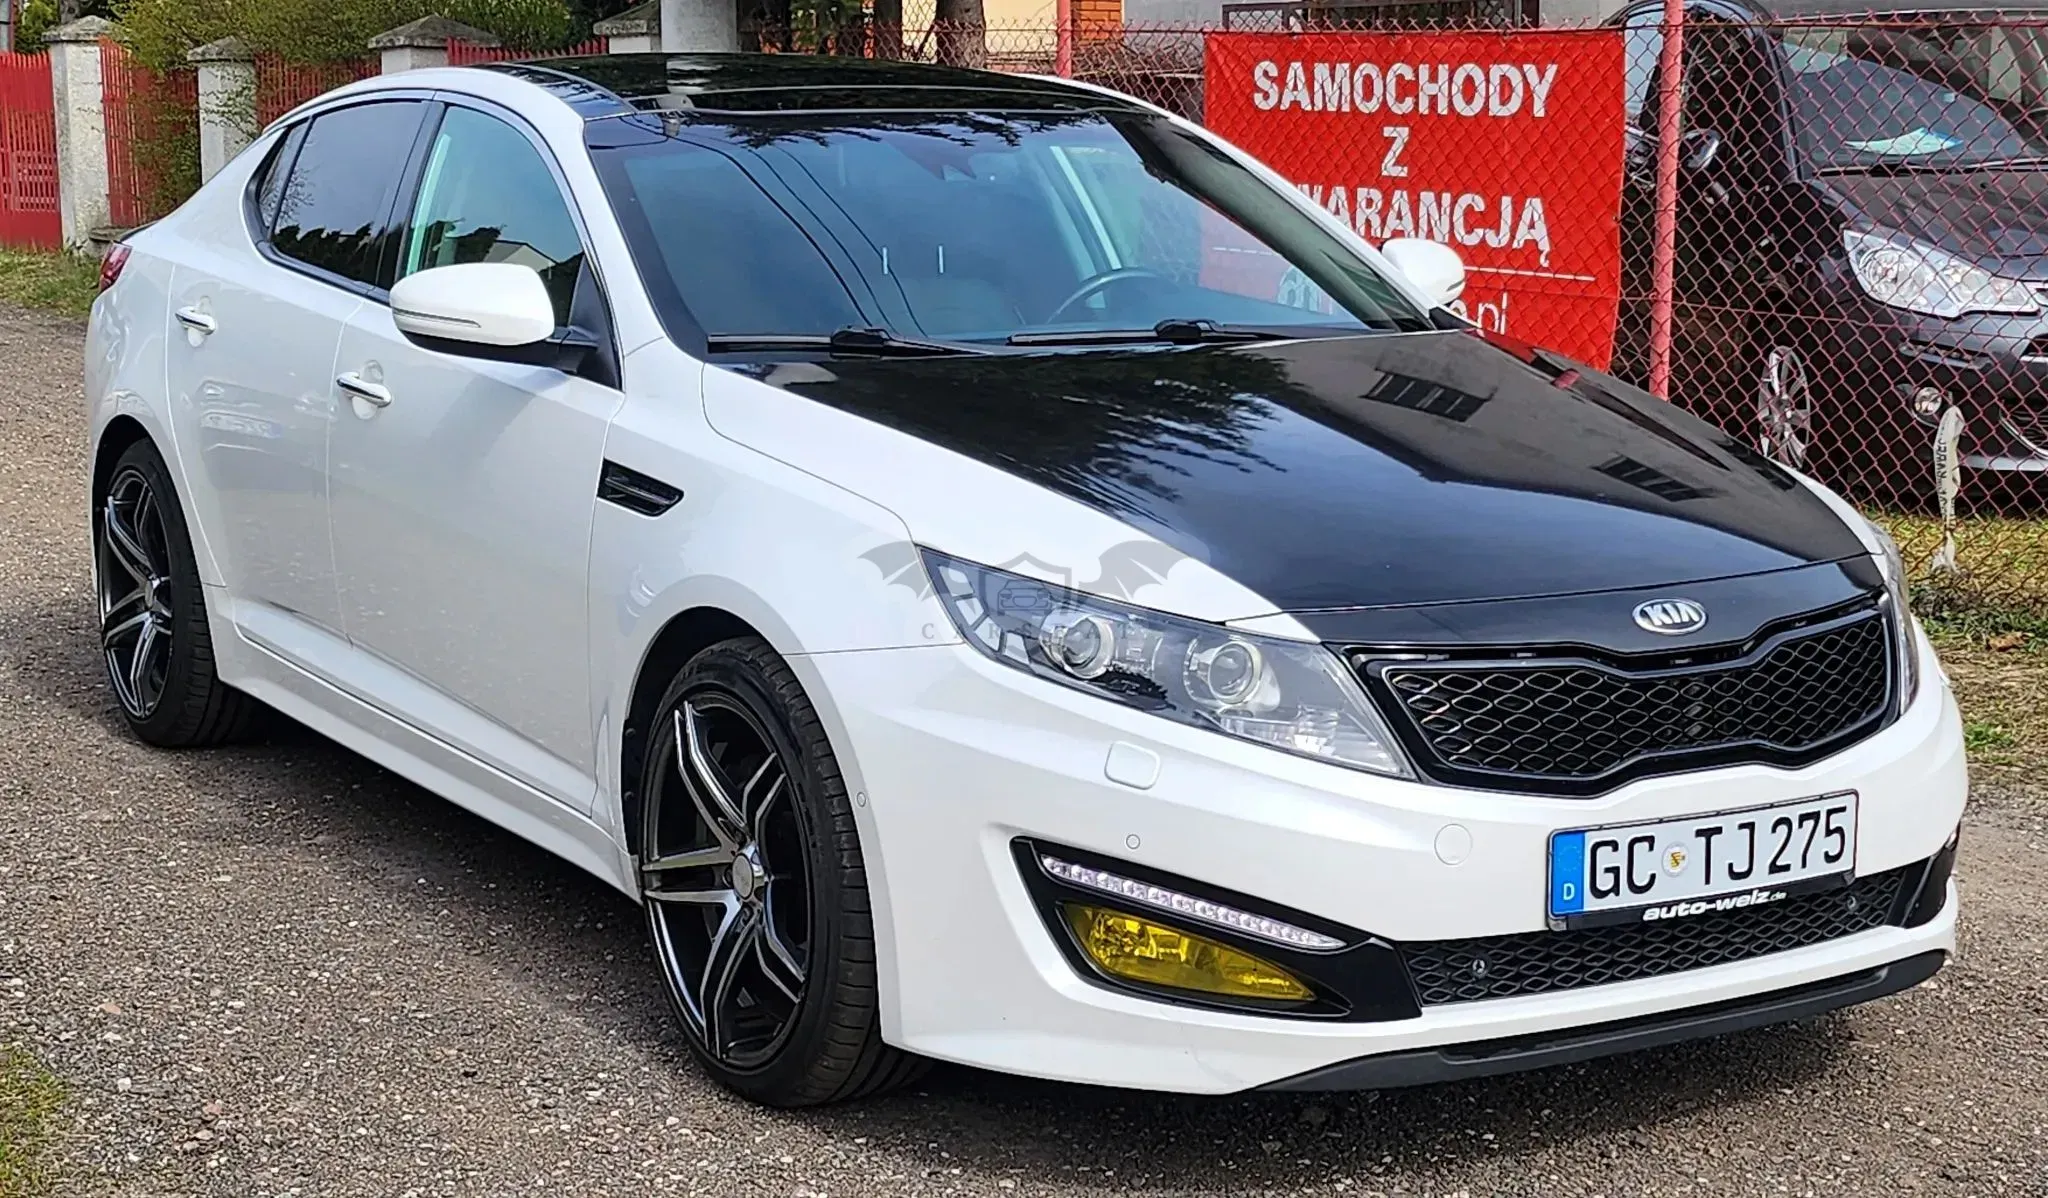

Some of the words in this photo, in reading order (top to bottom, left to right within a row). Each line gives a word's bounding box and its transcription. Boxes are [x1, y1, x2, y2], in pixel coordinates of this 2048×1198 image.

[1253, 60, 1557, 117] SAMOCHODY
[1381, 126, 1409, 177] Z
[1642, 602, 1700, 626] KIA
[1589, 835, 1656, 899] GC
[1695, 822, 1755, 885] TJ
[1769, 805, 1847, 875] 275
[1563, 883, 1575, 900] D
